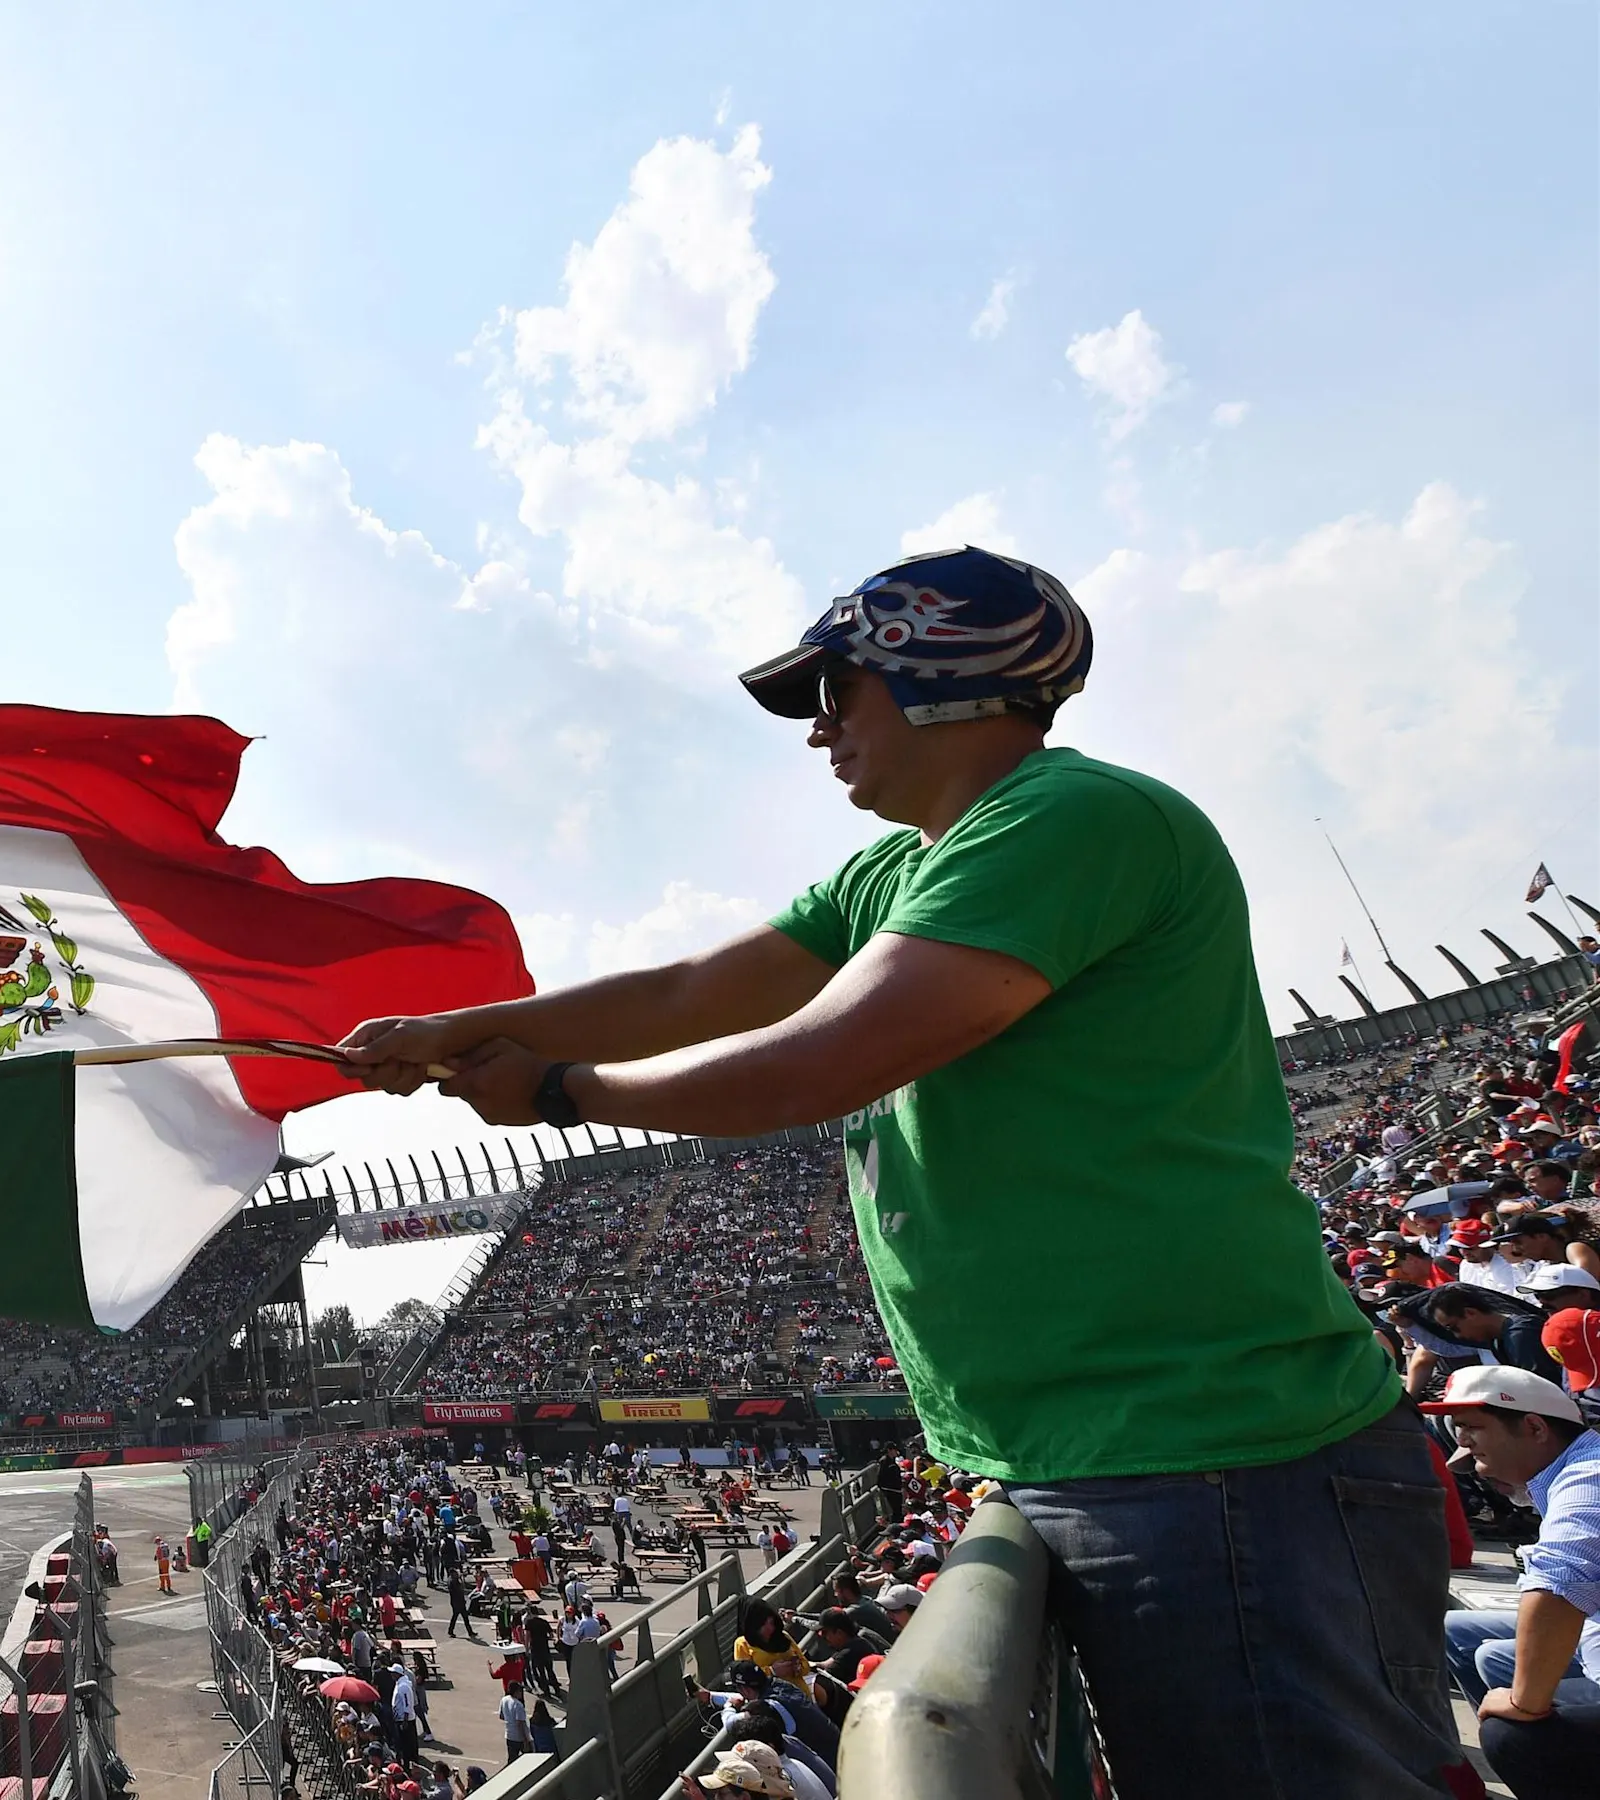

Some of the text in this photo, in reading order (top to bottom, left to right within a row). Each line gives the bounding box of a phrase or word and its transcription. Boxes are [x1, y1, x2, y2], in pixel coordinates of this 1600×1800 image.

[433, 1405, 502, 1420] Fly Emirates
[622, 1402, 682, 1418] PIRELLI
[832, 1407, 869, 1416] ROLEX
[63, 1414, 105, 1426] Fly Emirates
[911, 1480, 919, 1491] 8
